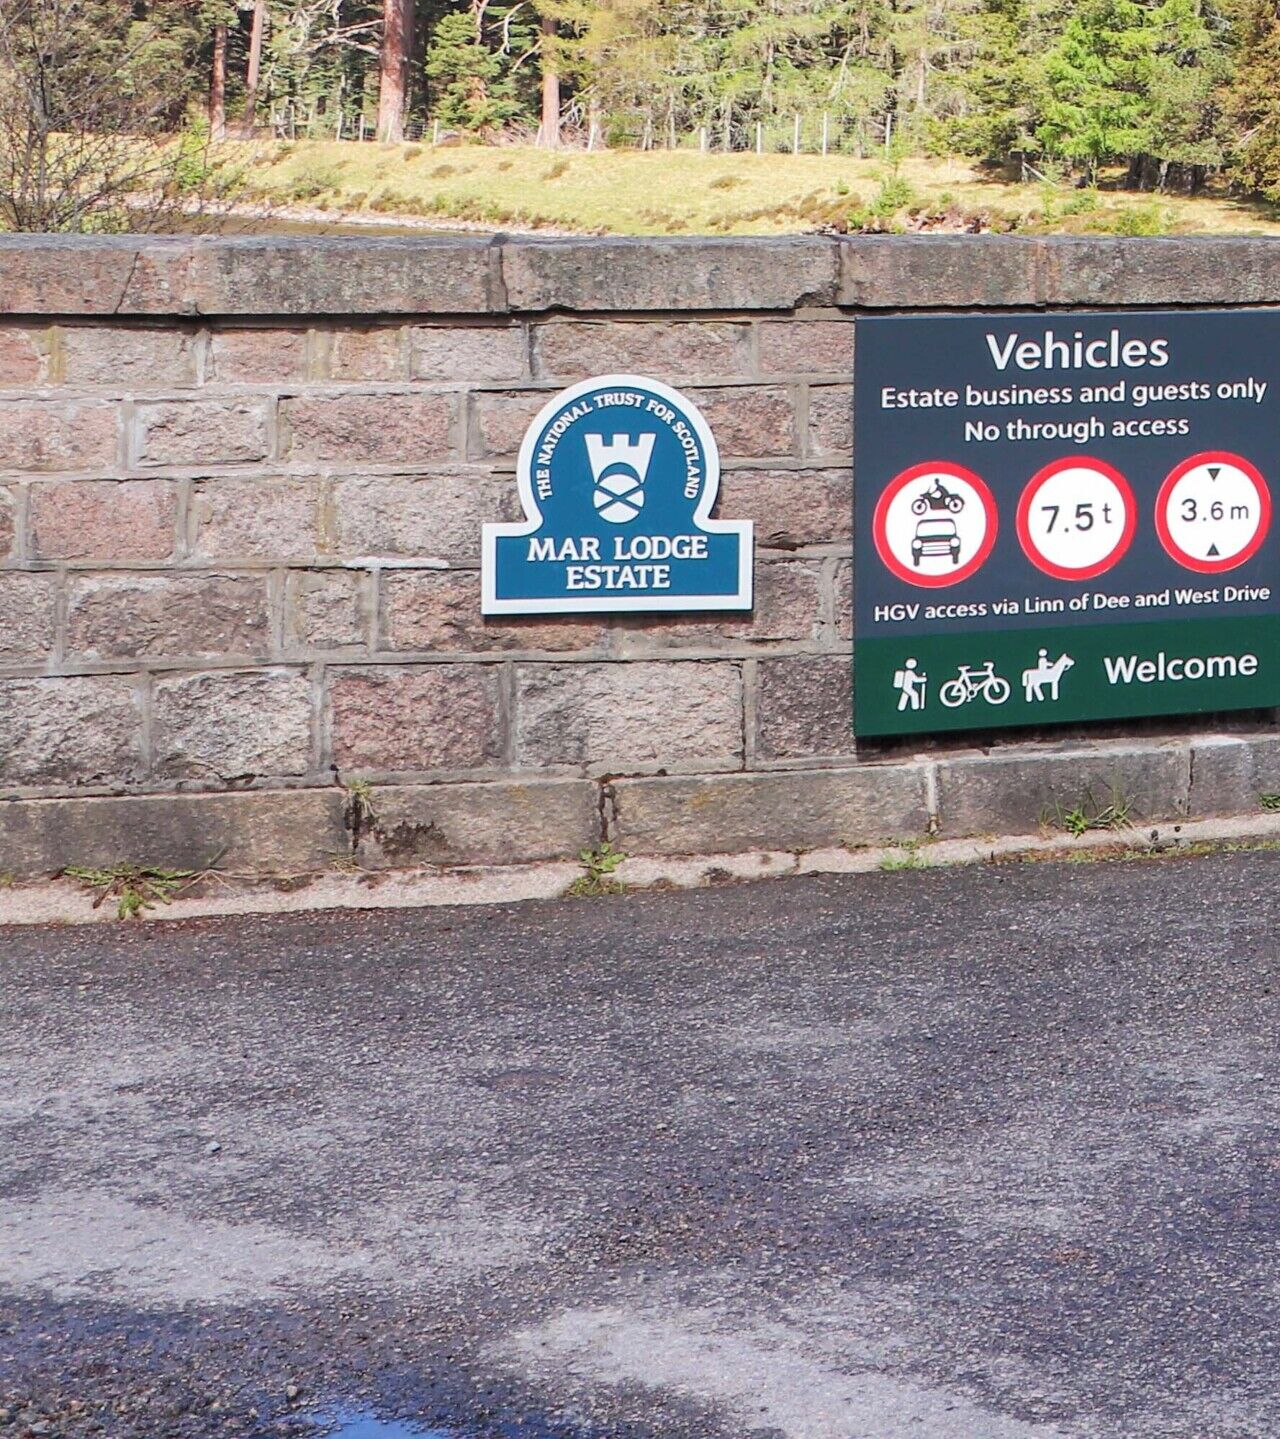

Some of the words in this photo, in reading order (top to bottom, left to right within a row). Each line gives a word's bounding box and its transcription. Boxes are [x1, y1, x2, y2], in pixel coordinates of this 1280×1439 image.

[985, 330, 1170, 370] Vehicles
[594, 393, 645, 408] TRUST
[881, 386, 959, 408] Estate
[965, 383, 1073, 406] business
[1079, 381, 1125, 402] and
[1132, 383, 1210, 406] guests
[1217, 378, 1267, 403] only
[646, 399, 676, 424] FOR
[538, 401, 593, 466] NATIONAL
[964, 421, 1000, 441] No
[1006, 416, 1105, 443] through
[1112, 419, 1189, 437] access
[672, 421, 701, 499] SCOTLAND
[536, 467, 552, 500] THE
[527, 537, 600, 561] MAR
[614, 536, 708, 560] LODGE
[566, 565, 670, 589] ESTATE
[874, 605, 919, 622] HGV
[924, 603, 987, 619] access
[992, 599, 1019, 615] via
[1024, 595, 1064, 613] Linn
[1069, 593, 1088, 611] of
[1094, 592, 1129, 609] Dee
[1135, 590, 1170, 607] and
[1175, 588, 1219, 605] West
[1224, 585, 1270, 602] Drive
[1104, 652, 1258, 684] Welcome
